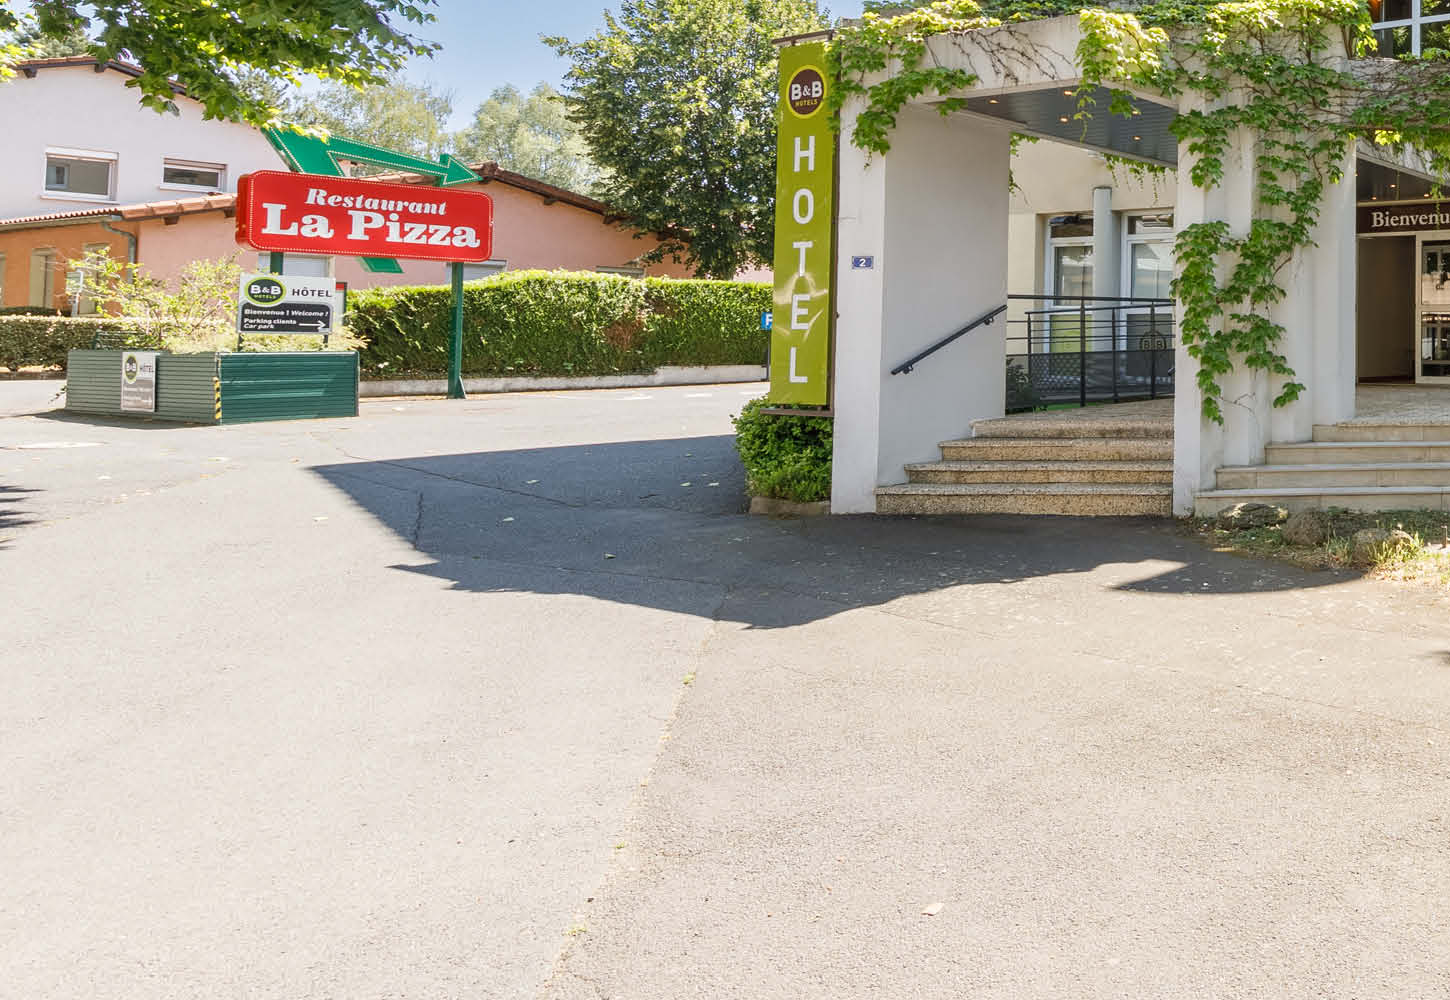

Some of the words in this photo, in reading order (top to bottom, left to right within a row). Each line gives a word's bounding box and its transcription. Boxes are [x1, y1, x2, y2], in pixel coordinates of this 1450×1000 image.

[790, 81, 823, 100] B&B
[795, 99, 818, 107] HOTELS
[305, 188, 447, 215] Restaurant
[261, 203, 335, 239] La
[347, 210, 481, 248] Pizza
[789, 135, 815, 383] HOTEL
[858, 258, 866, 267] 2
[250, 285, 282, 295] B&B
[292, 287, 333, 297] HÔTEL
